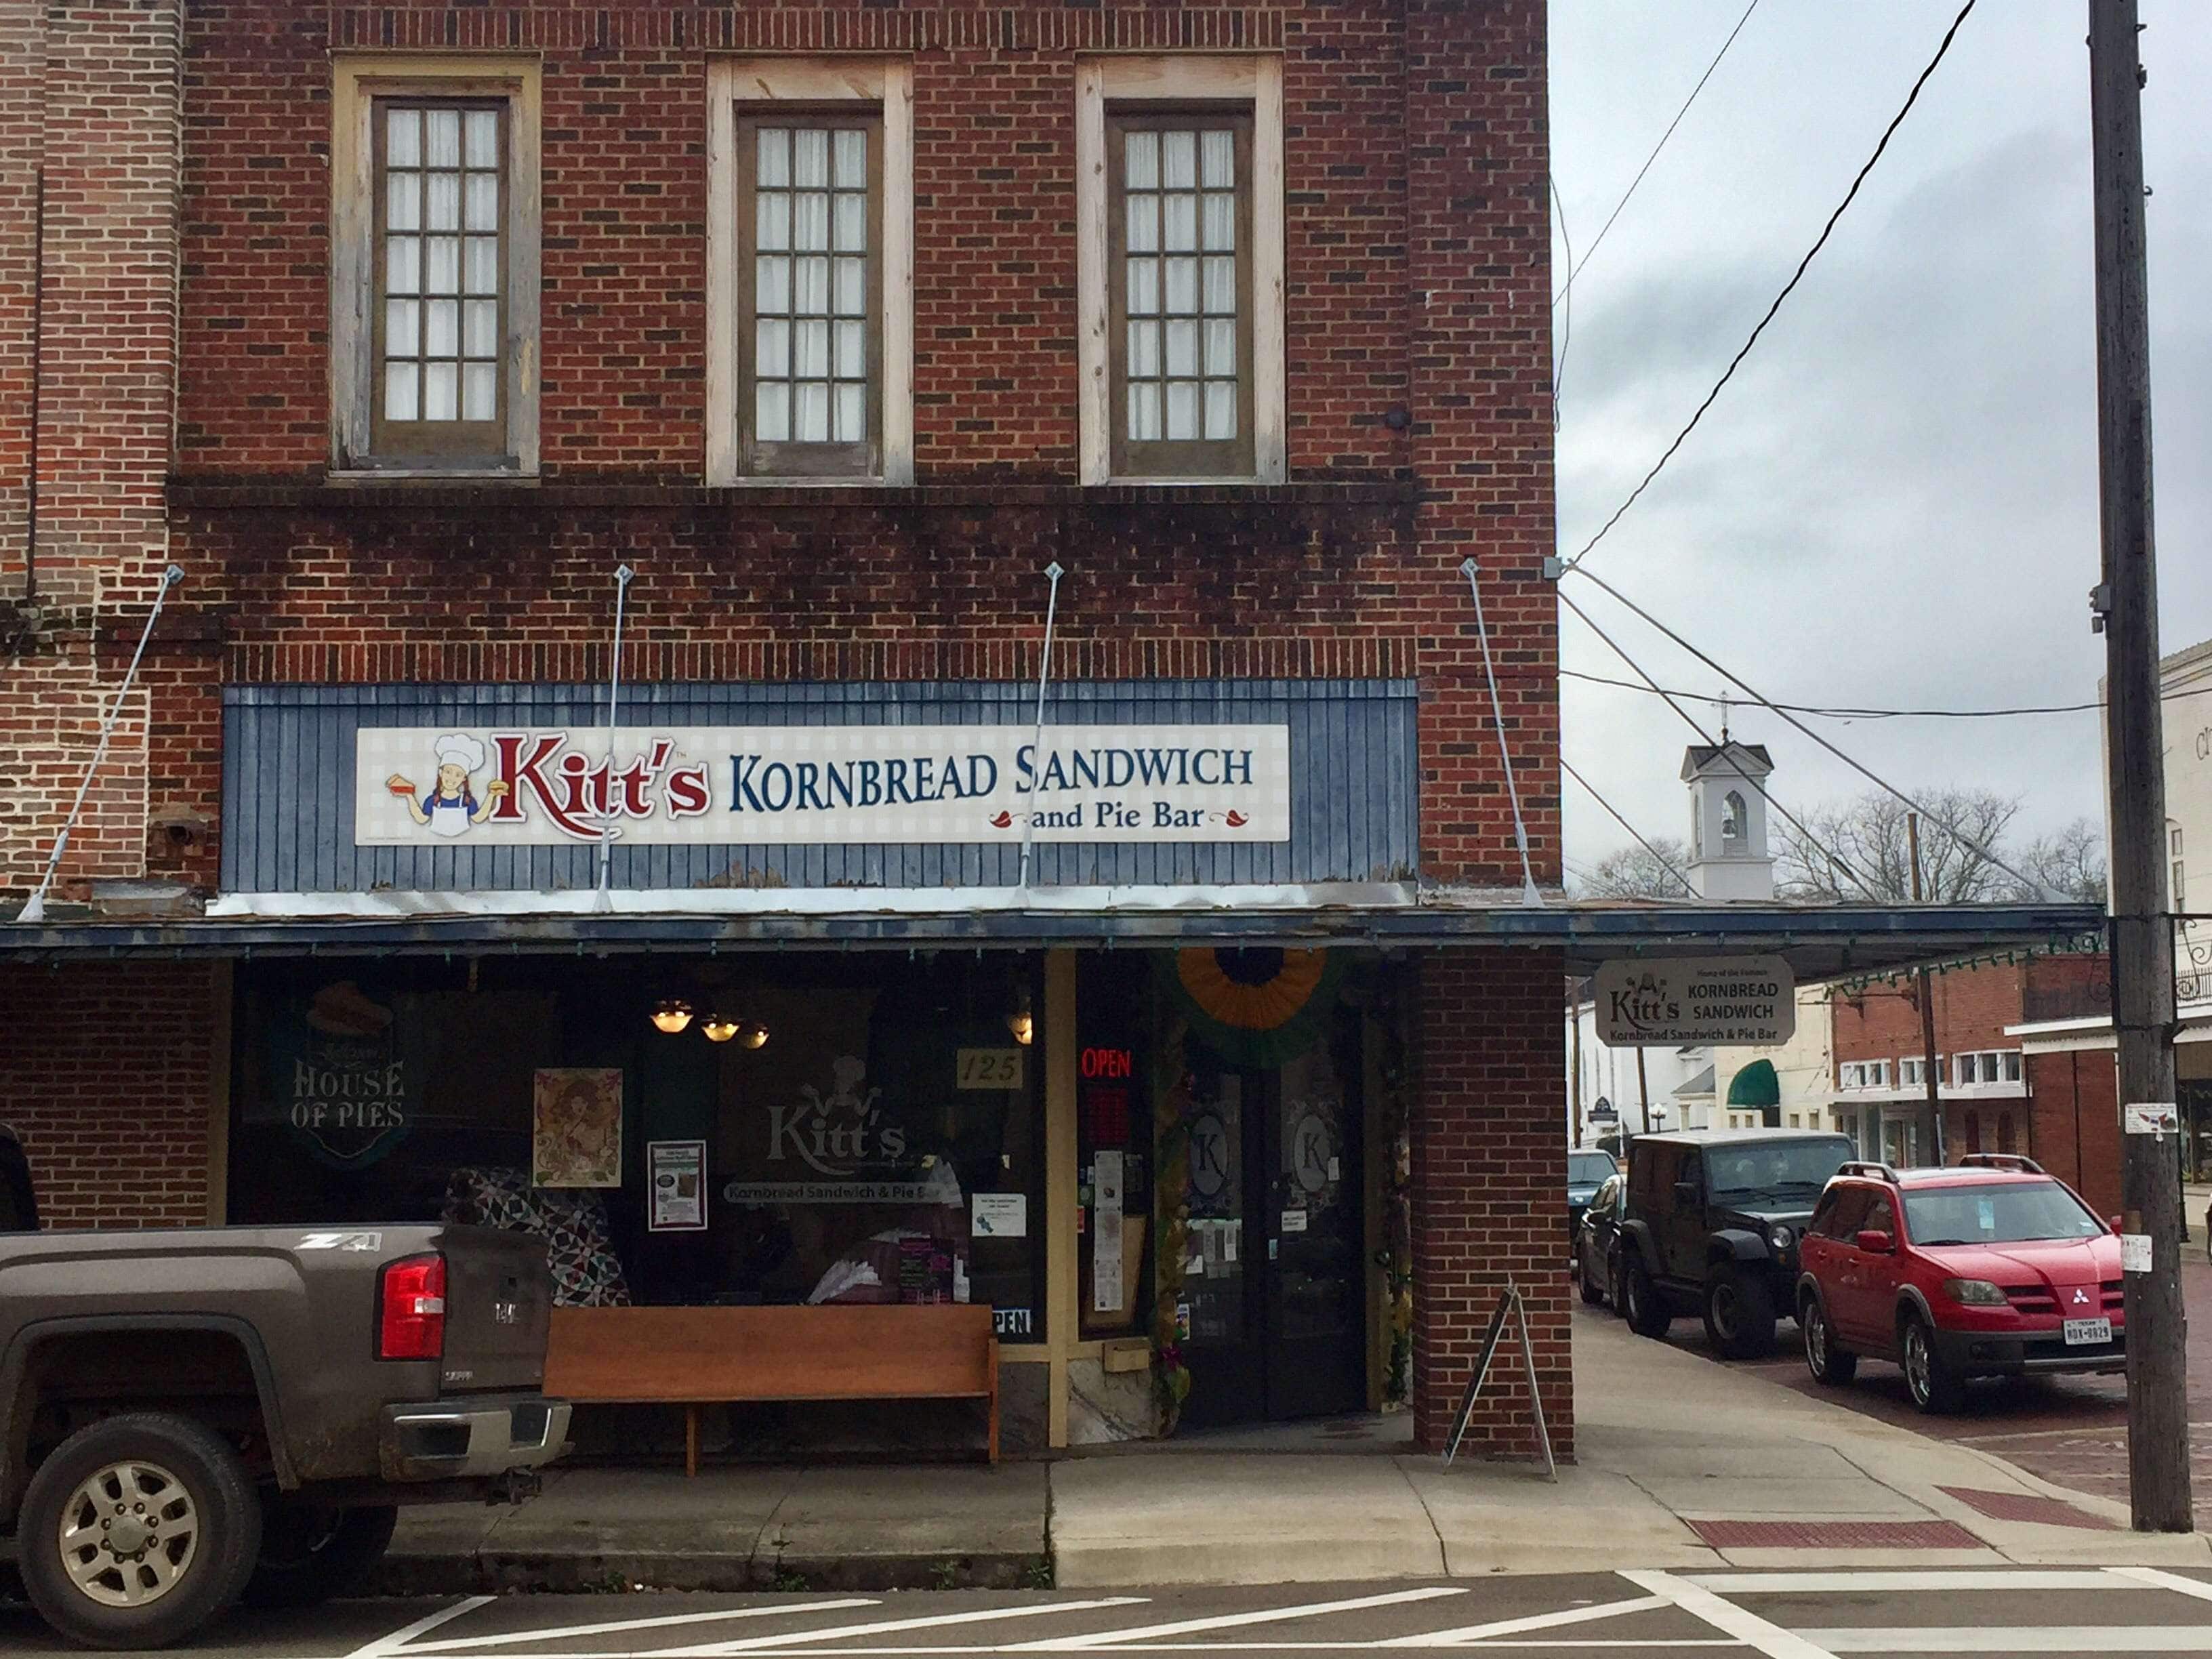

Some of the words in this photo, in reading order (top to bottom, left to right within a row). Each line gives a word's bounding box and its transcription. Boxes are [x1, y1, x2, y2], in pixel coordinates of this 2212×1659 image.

[489, 733, 711, 840] Kitt's
[729, 754, 998, 812] KORNBREAD
[1015, 745, 1253, 794] SANDWICH
[1031, 803, 1082, 828] and
[1095, 801, 1141, 828] Pie
[1153, 801, 1204, 828] Bar
[1688, 983, 1778, 999] KORNBREAD
[1610, 990, 1679, 1031] Kitt's
[1694, 1004, 1774, 1019] SANDWICH
[1610, 1028, 1667, 1041] Kornbread
[1671, 1029, 1723, 1040] Sandwich
[1727, 1028, 1734, 1039] &
[1738, 1027, 1754, 1039] Pie
[1758, 1027, 1777, 1039] Bar
[963, 1054, 1017, 1081] 125
[1082, 1047, 1132, 1078] OPEN
[291, 1101, 328, 1128] OF
[337, 1101, 404, 1128] PIES
[766, 1105, 905, 1175] Kitt's
[807, 1185, 875, 1198] Sandwich
[892, 1186, 914, 1199] Pie
[992, 1311, 1027, 1334] PEN
